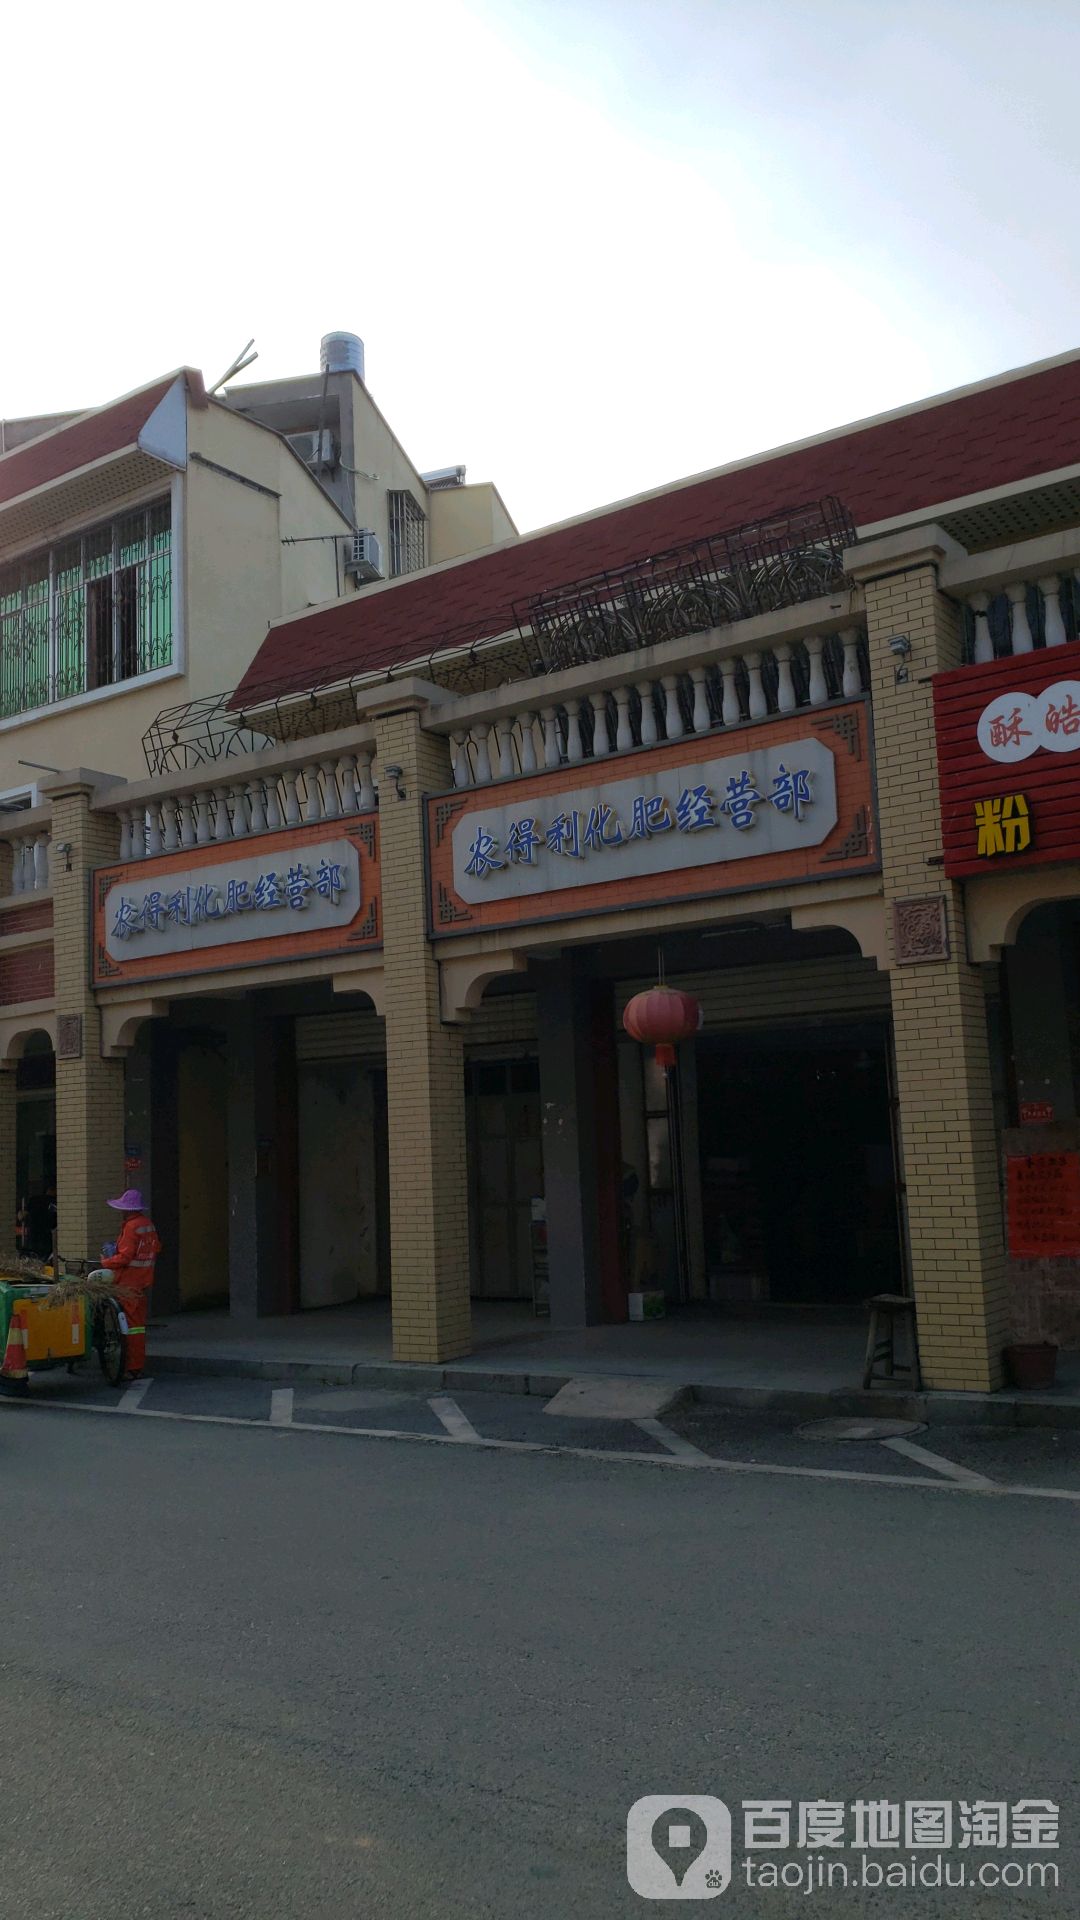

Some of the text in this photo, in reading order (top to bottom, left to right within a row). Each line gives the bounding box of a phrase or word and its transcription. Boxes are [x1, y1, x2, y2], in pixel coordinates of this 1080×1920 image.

[464, 763, 812, 878] 农得利化肥经营部
[974, 793, 1031, 856] 粉
[111, 859, 342, 939] 农得利化肥经营部
